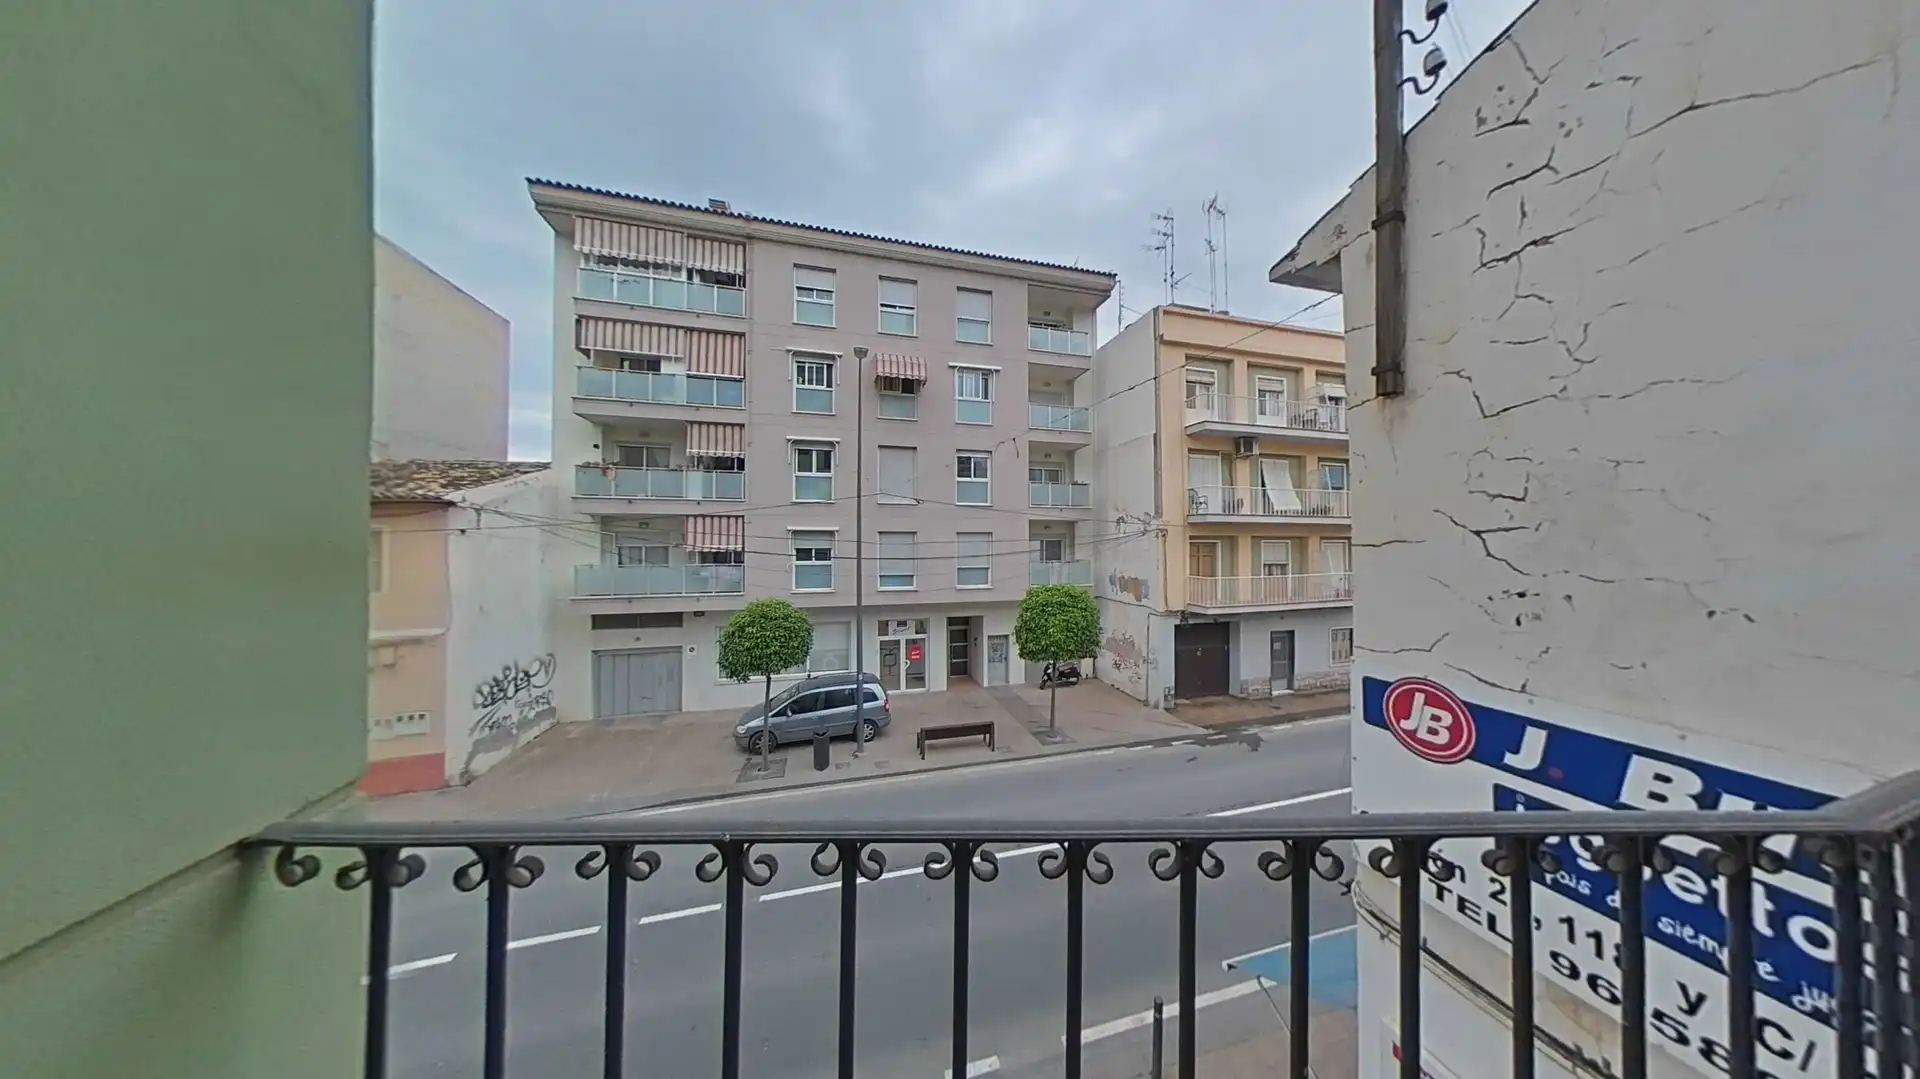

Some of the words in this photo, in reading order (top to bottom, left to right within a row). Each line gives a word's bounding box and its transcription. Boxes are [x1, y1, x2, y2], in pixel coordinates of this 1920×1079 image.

[1399, 691, 1453, 745] JB
[1548, 949, 1622, 1006] 96
[1675, 980, 1707, 1016] y
